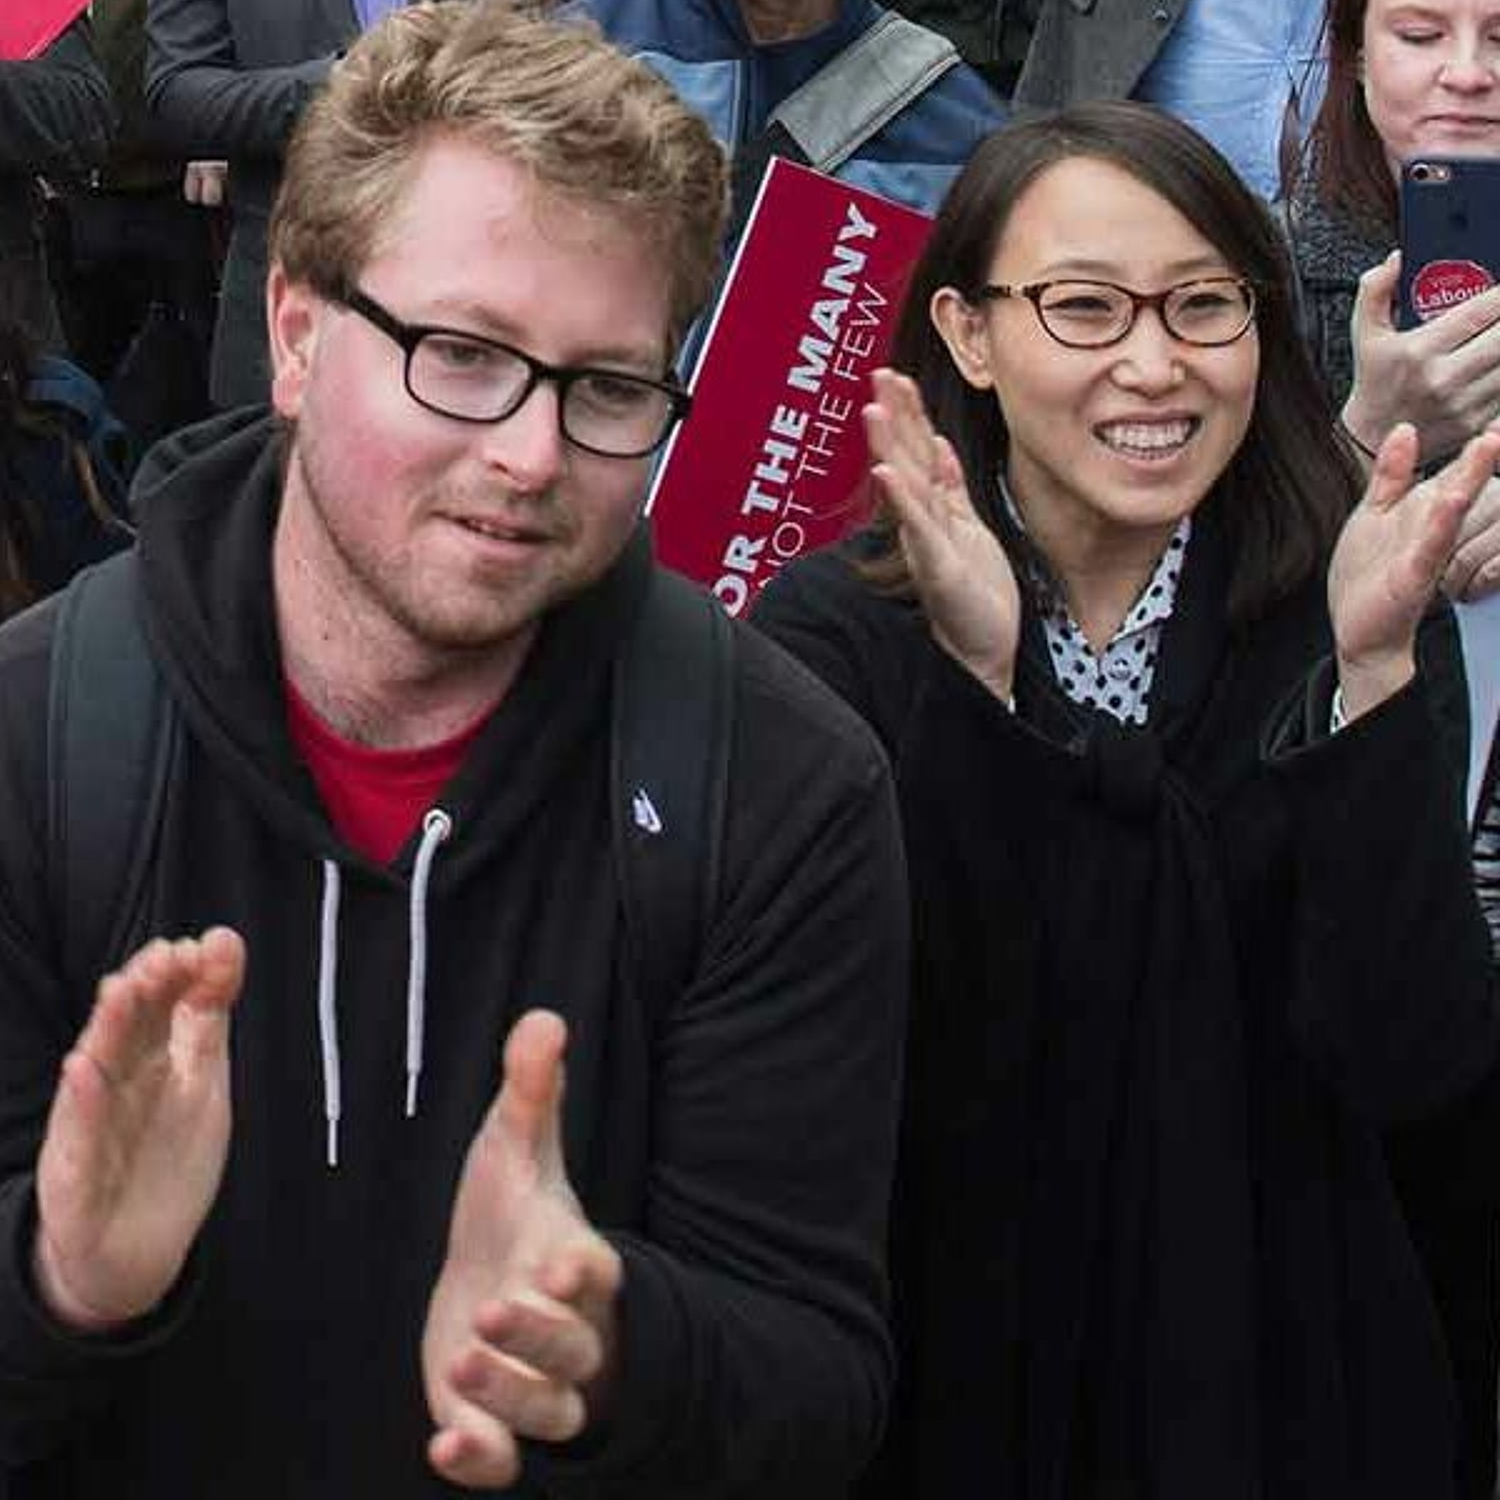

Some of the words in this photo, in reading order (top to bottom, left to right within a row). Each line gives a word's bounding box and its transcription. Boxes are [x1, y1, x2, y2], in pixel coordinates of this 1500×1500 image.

[711, 534, 768, 619] OR
[740, 403, 809, 518] THE
[787, 202, 878, 394] MANY
[796, 393, 853, 477] THE
[833, 282, 889, 380] FEW
